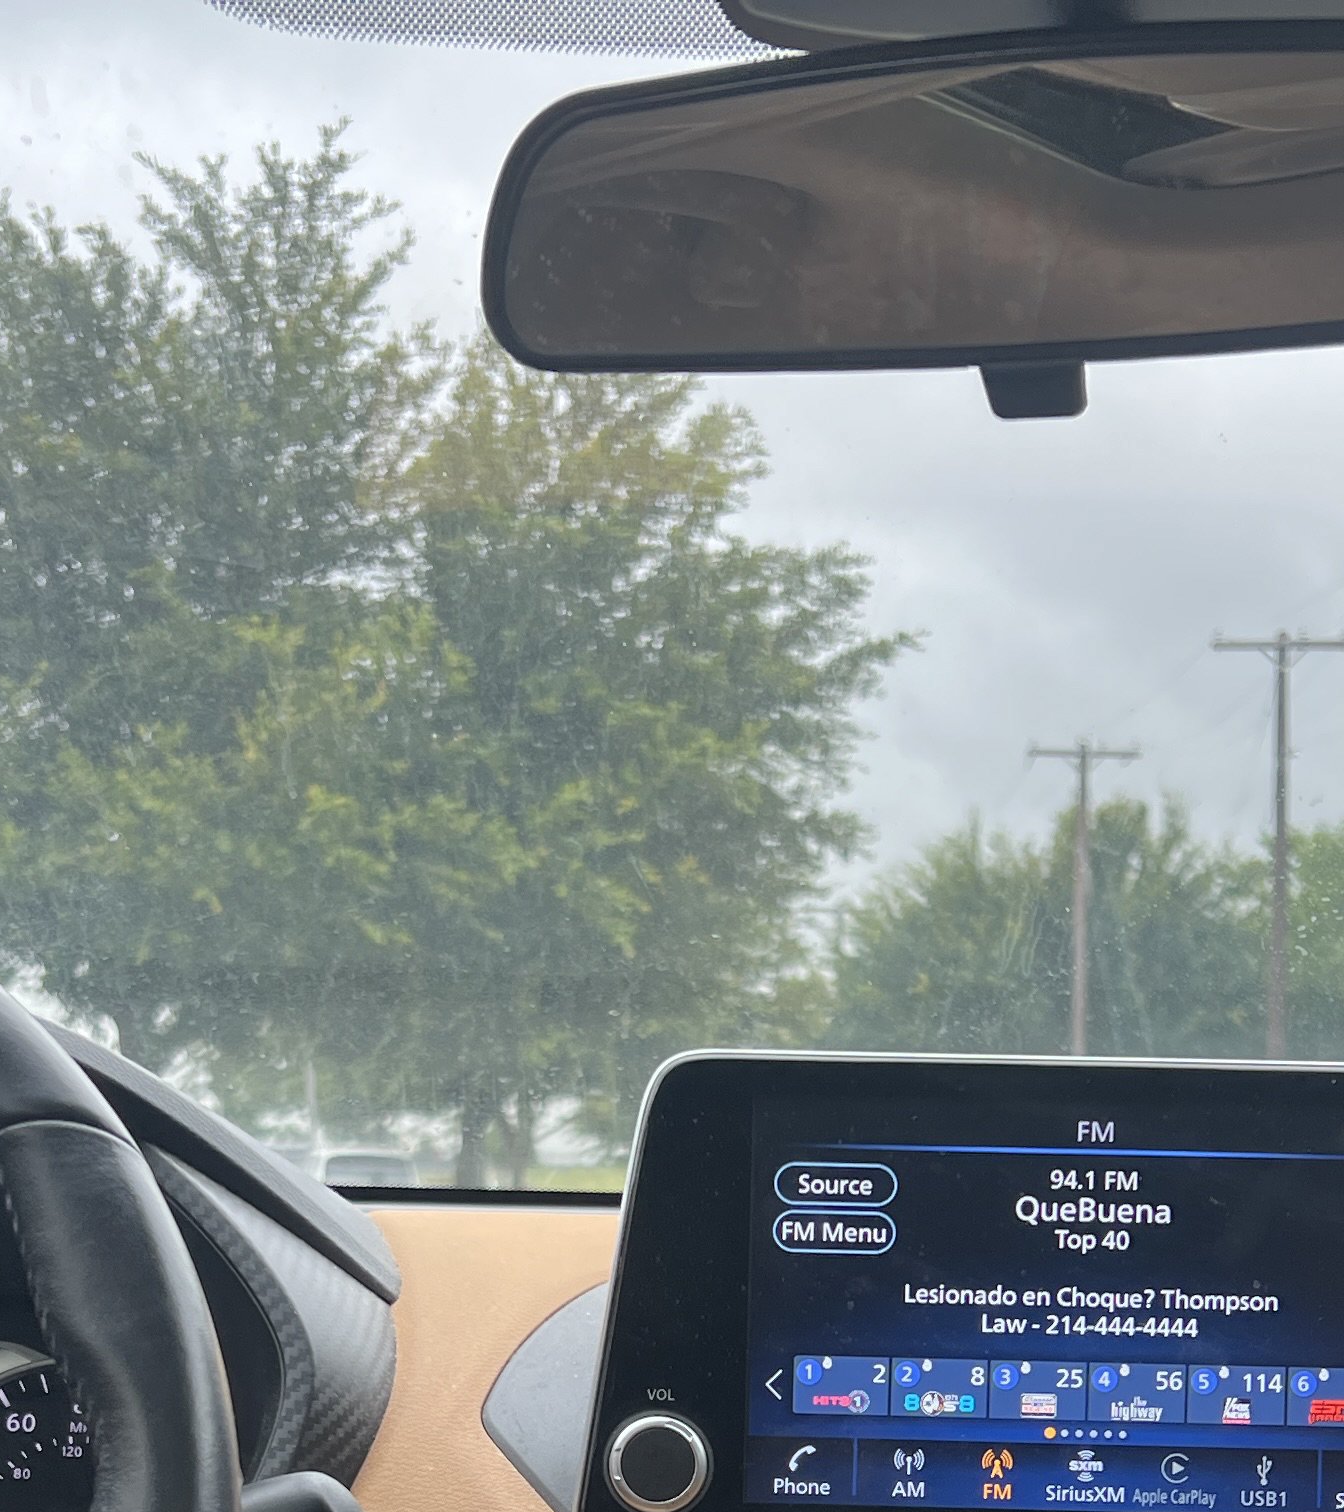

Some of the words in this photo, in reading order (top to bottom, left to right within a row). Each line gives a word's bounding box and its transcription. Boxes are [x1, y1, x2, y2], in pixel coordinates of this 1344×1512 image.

[1077, 1121, 1115, 1143] FM
[797, 1173, 873, 1196] Source
[1049, 1169, 1097, 1191] 94.1
[1104, 1171, 1139, 1191] FM
[1015, 1195, 1172, 1227] QueBuena
[781, 1221, 816, 1243] FM
[822, 1222, 887, 1243] Menu
[1054, 1229, 1097, 1253] Top
[1101, 1230, 1130, 1251] 40
[903, 1283, 1018, 1307] Lesionado
[1022, 1290, 1052, 1307] en
[1056, 1286, 1156, 1313] Choque?
[1160, 1288, 1279, 1315] Thompson
[981, 1313, 1028, 1336] Law
[1045, 1315, 1199, 1339] 214-444-4444
[805, 1363, 813, 1380] 1
[872, 1364, 887, 1384] 2
[901, 1366, 913, 1383] 2
[970, 1366, 985, 1387] 8
[999, 1368, 1011, 1386] 3
[1055, 1368, 1084, 1389] 25
[1098, 1371, 1111, 1388] 4
[1155, 1371, 1184, 1391] 56
[1198, 1373, 1209, 1390] 5
[1242, 1373, 1284, 1393] 114
[1297, 1376, 1310, 1392] 6
[646, 1388, 676, 1402] VOL
[6, 1412, 37, 1433] 60
[12, 1467, 32, 1481] 80
[772, 1478, 831, 1496] Phone
[892, 1481, 926, 1499] AM
[983, 1483, 1012, 1500] FM
[1045, 1485, 1126, 1504] SiriusXM
[1132, 1488, 1168, 1508] Apple
[1170, 1489, 1217, 1510] CarPlay
[1240, 1491, 1288, 1508] USB1
